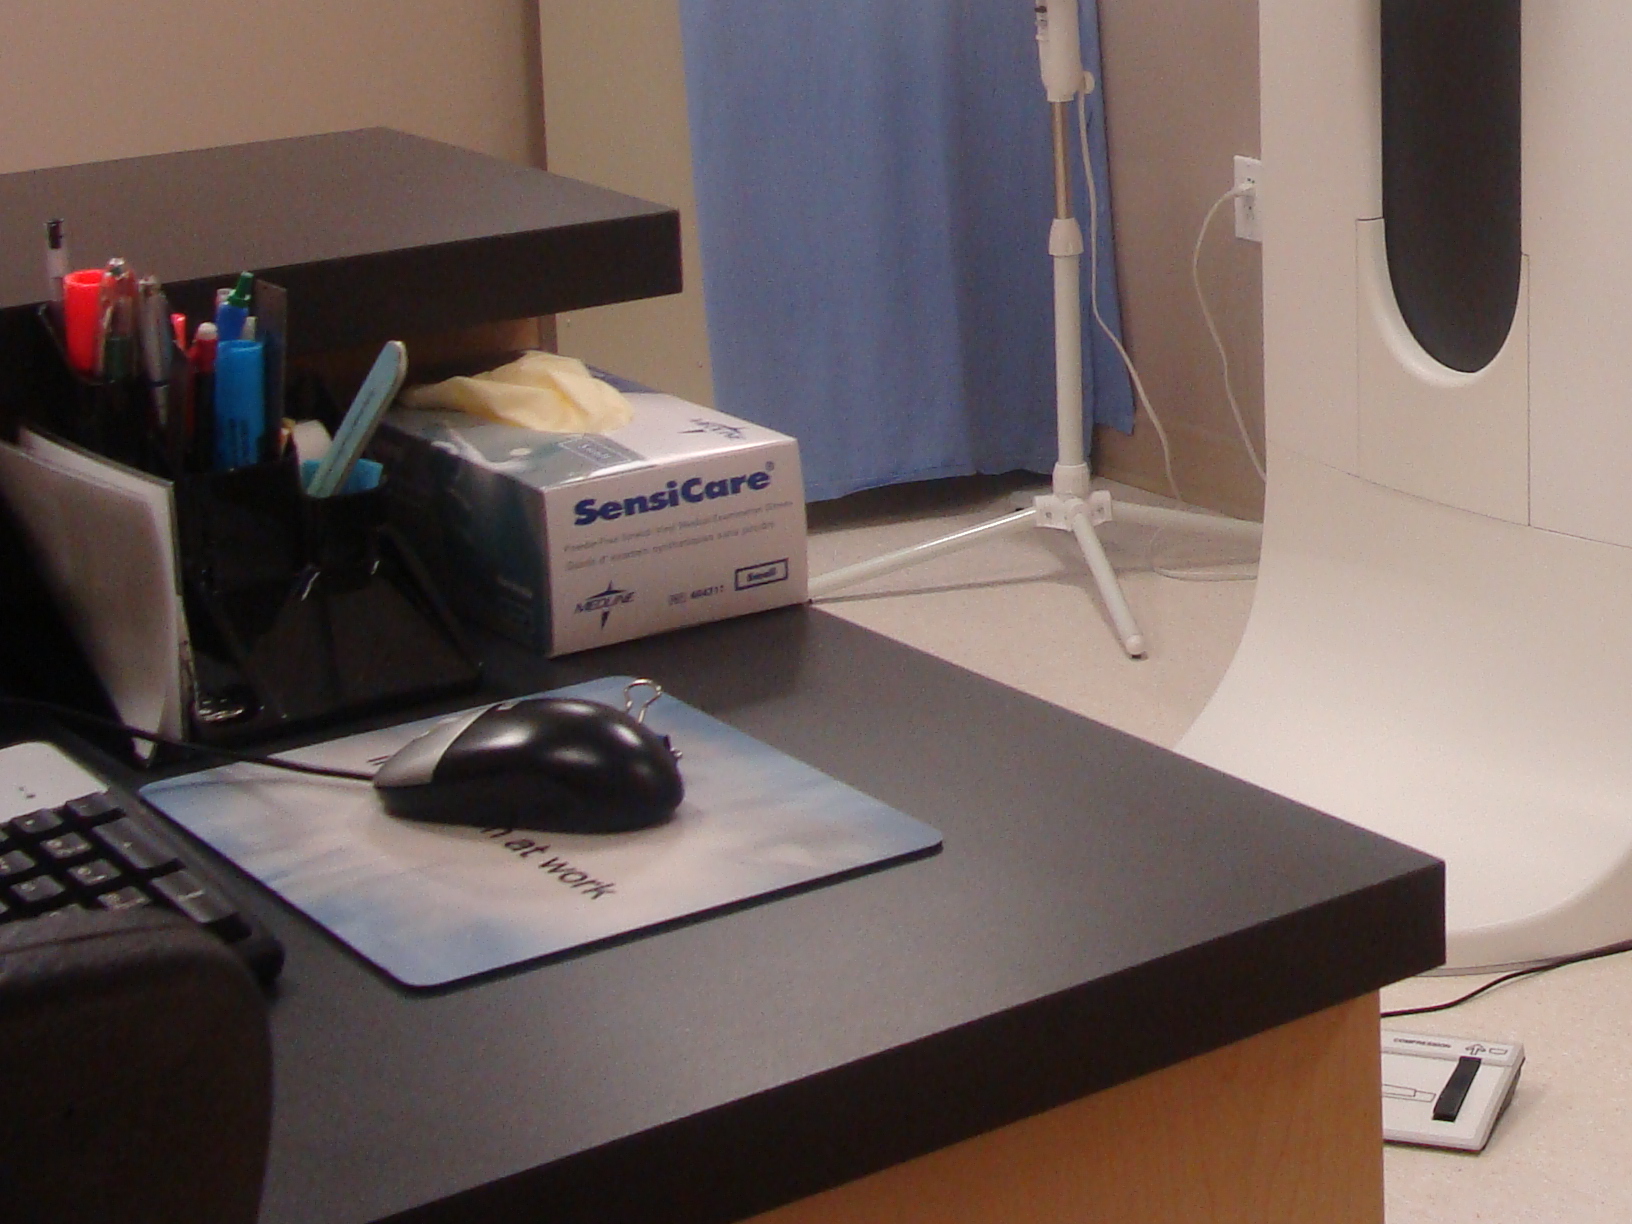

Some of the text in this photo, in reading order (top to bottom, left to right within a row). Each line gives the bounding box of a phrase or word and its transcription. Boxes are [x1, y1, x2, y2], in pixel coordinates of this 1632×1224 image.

[573, 470, 772, 526] SensiCare
[504, 838, 616, 900] at work
